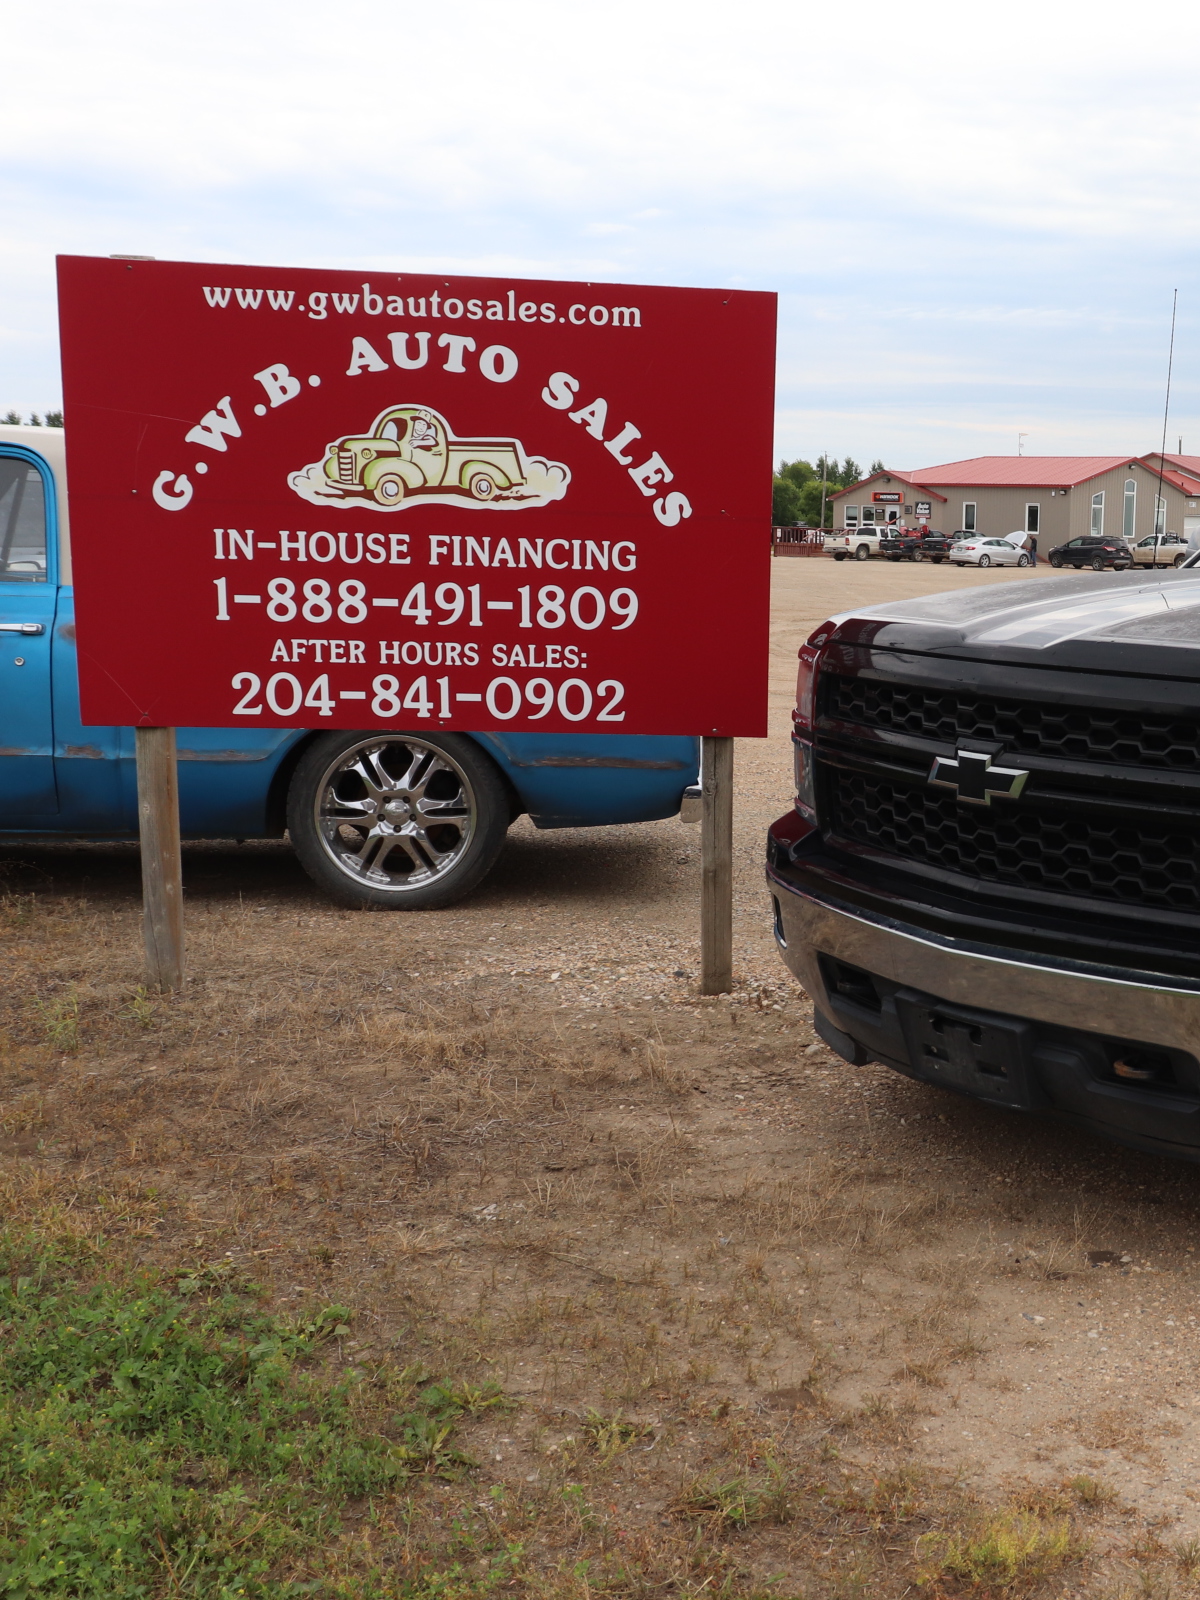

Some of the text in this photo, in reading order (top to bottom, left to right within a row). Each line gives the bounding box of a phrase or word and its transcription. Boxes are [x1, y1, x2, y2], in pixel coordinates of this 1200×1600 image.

[202, 283, 642, 328] www.gwbautosales.com
[152, 332, 692, 527] G.W.B. AUTO SALES
[214, 529, 637, 572] IN-HOUSE FINANCING
[213, 577, 639, 631] 1-888-491-1809
[270, 639, 588, 669] AFTER HOURS SALES:
[232, 672, 626, 722] 204-841-0902
